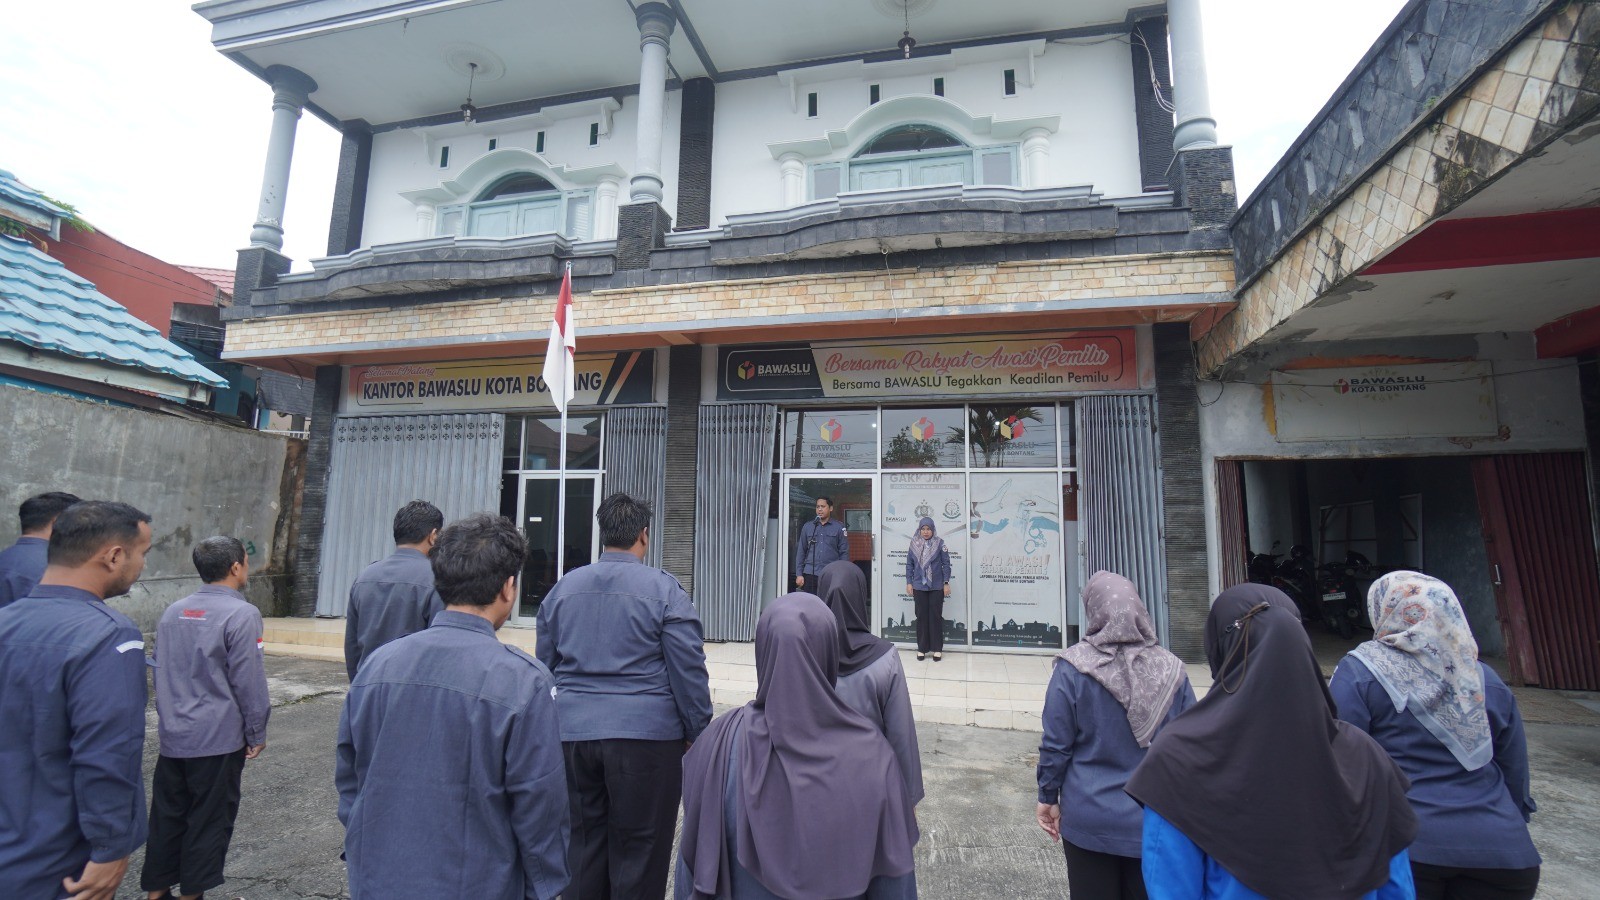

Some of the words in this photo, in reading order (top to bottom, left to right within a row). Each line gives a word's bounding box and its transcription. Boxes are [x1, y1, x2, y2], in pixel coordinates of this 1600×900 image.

[825, 352, 900, 374] Bersama
[900, 350, 972, 375] Rakyat
[971, 346, 1038, 368] Awasi
[1037, 343, 1109, 369] Pemilu
[365, 366, 400, 378] Selamat
[399, 365, 435, 377] Datang
[757, 363, 811, 376] BAWASLU
[363, 381, 415, 400] KANTOR
[418, 378, 480, 398] BAWASLU
[485, 376, 521, 395] KOTA
[526, 372, 602, 394] BONG
[833, 378, 881, 390] Bersama
[885, 376, 942, 388] BAWASLU
[946, 374, 1002, 388] Tegakkan
[1010, 373, 1064, 385] Keadilan
[1068, 372, 1109, 383] Pemilu
[1350, 375, 1425, 385] BAWASLU
[1379, 384, 1426, 392] BONTANG
[810, 444, 852, 452] BAWASLU
